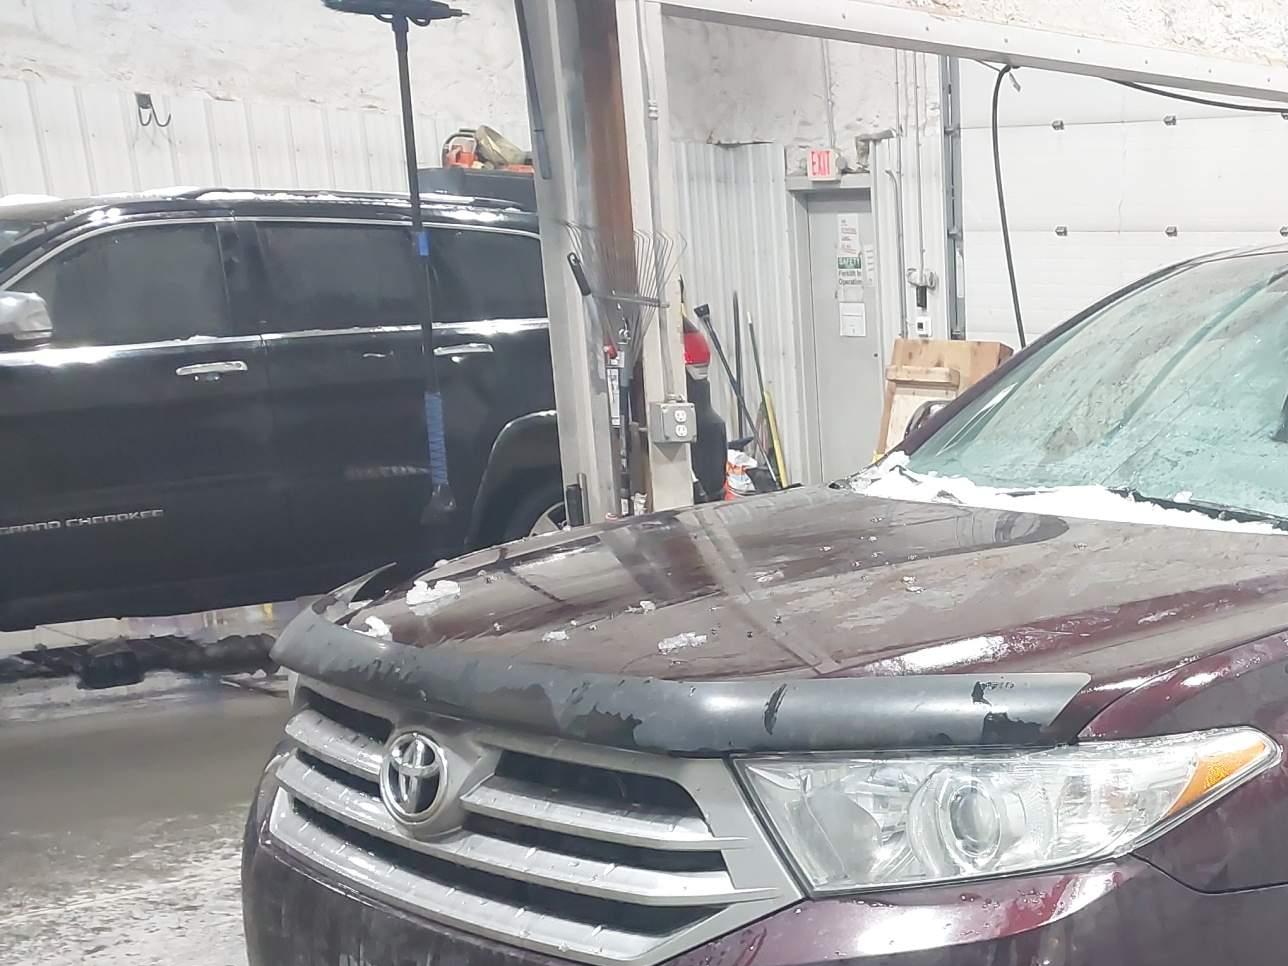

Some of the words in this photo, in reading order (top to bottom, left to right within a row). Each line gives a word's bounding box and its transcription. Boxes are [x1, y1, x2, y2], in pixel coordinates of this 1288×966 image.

[811, 151, 830, 176] EXIT
[0, 521, 61, 535] GRAND
[65, 509, 164, 527] CHEROKEE
